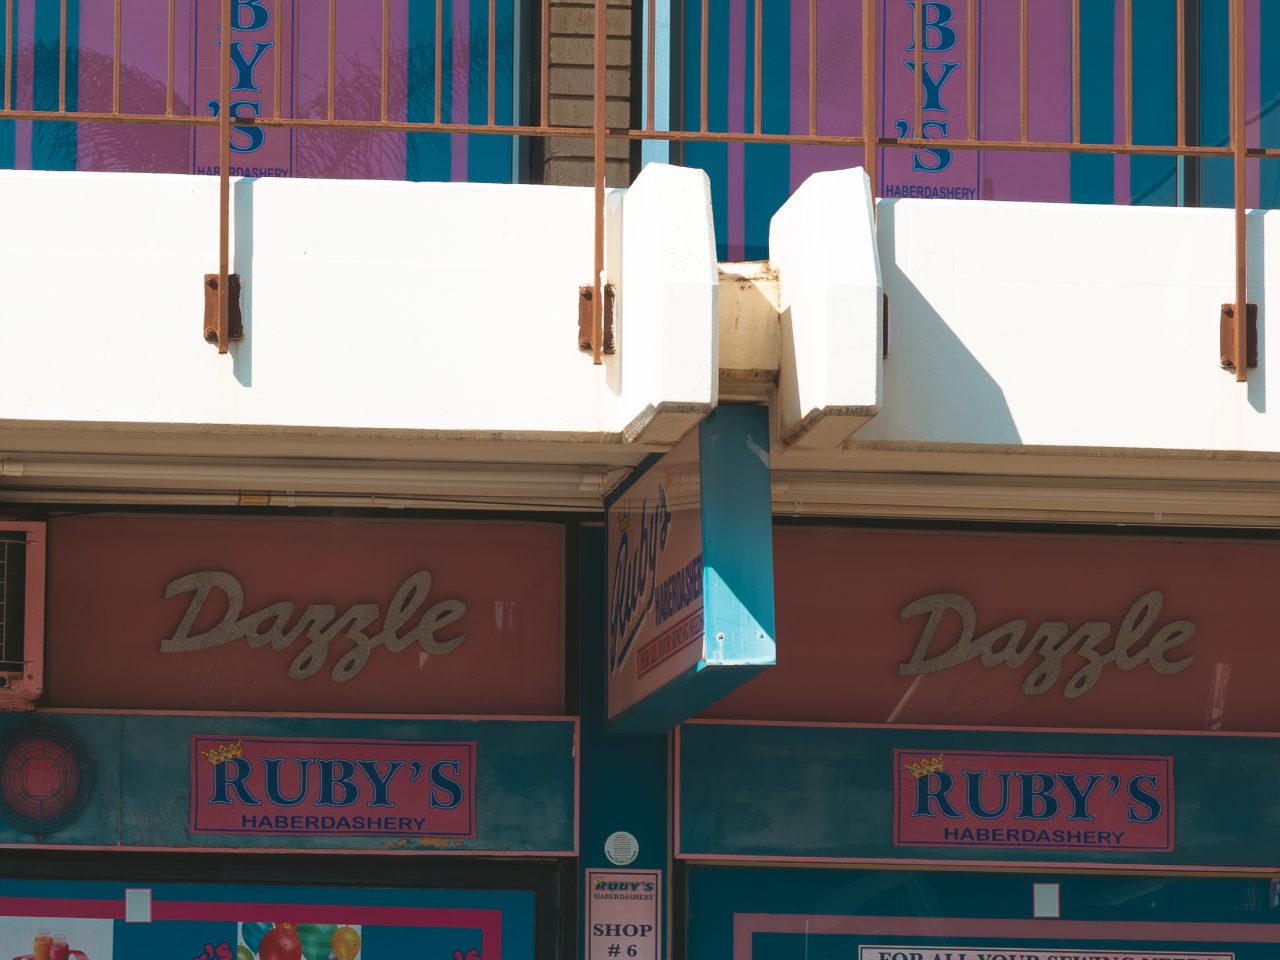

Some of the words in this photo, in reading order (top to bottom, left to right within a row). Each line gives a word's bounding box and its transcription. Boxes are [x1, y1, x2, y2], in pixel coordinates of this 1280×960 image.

[197, 165, 289, 178] HABRDASHERY
[885, 185, 976, 200] HABERDASHERY
[160, 570, 468, 683] Dazzle
[897, 590, 1199, 699] Dazzle
[207, 756, 464, 810] RUBY'S
[911, 769, 1162, 824] RUBY'S
[241, 814, 426, 832] HABERDASHERY
[943, 827, 1125, 845] HABERDASHERY
[595, 880, 655, 891] RUBY'S
[593, 924, 653, 937] SHOP
[608, 944, 620, 957] #
[627, 944, 637, 957] 6
